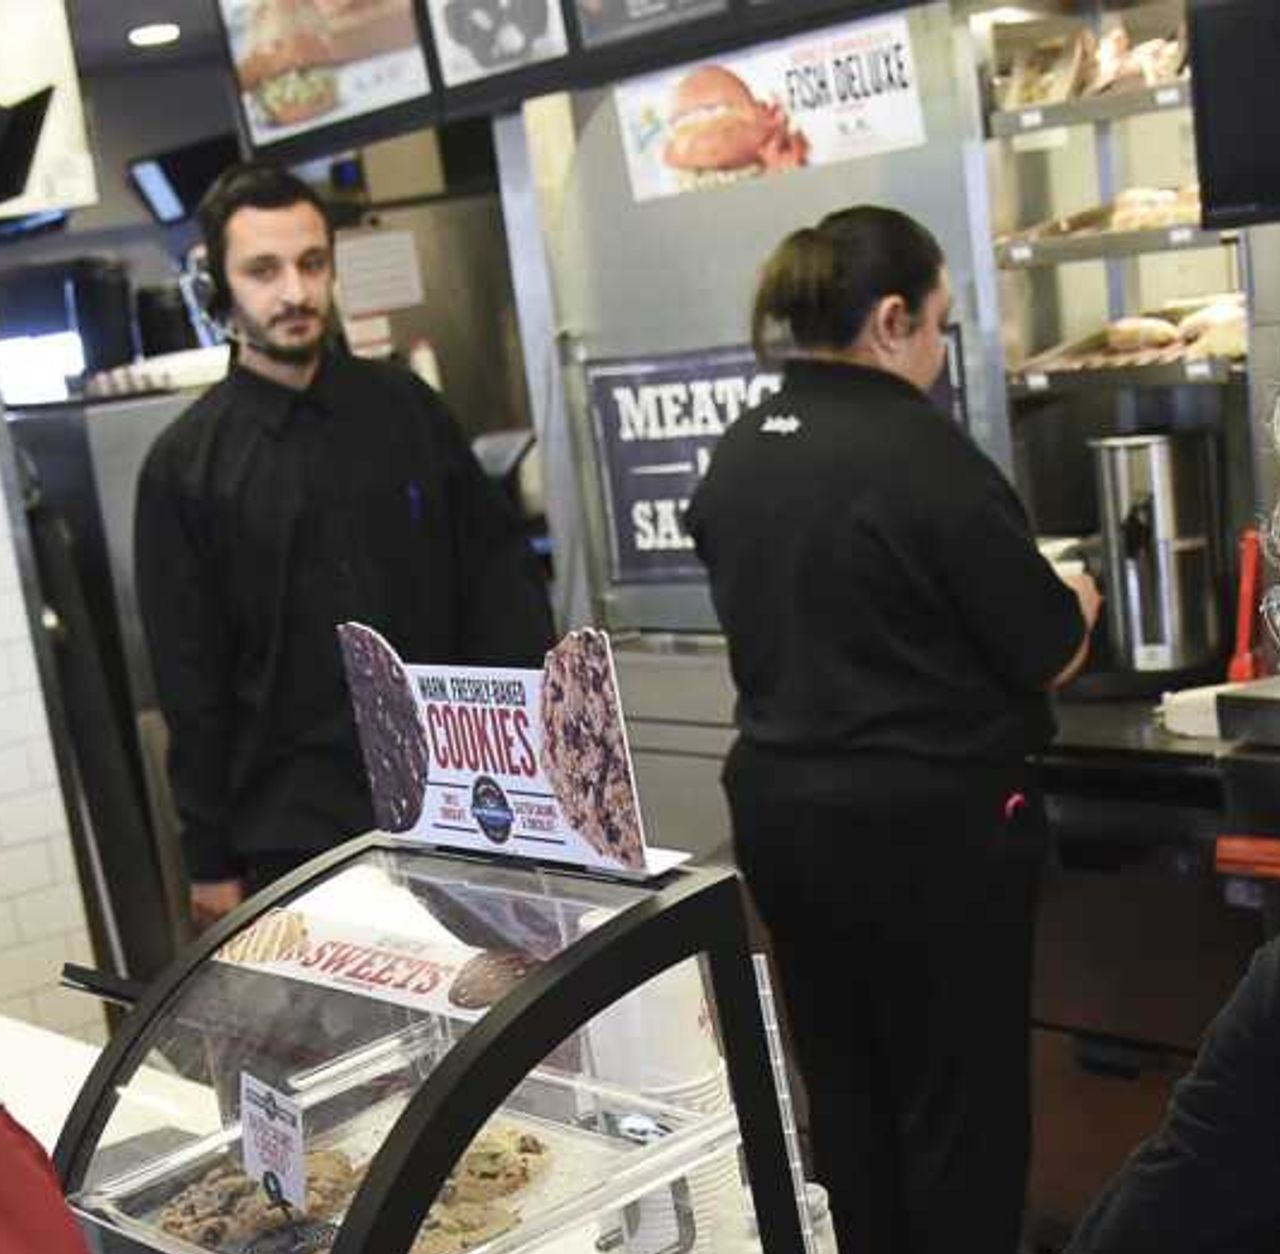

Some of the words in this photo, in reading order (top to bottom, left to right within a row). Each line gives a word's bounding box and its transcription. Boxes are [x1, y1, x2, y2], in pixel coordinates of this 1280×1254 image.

[785, 65, 832, 110] FISH
[833, 43, 908, 101] DELUXE
[426, 702, 537, 778] COOKIES
[302, 940, 442, 995] SWEETS
